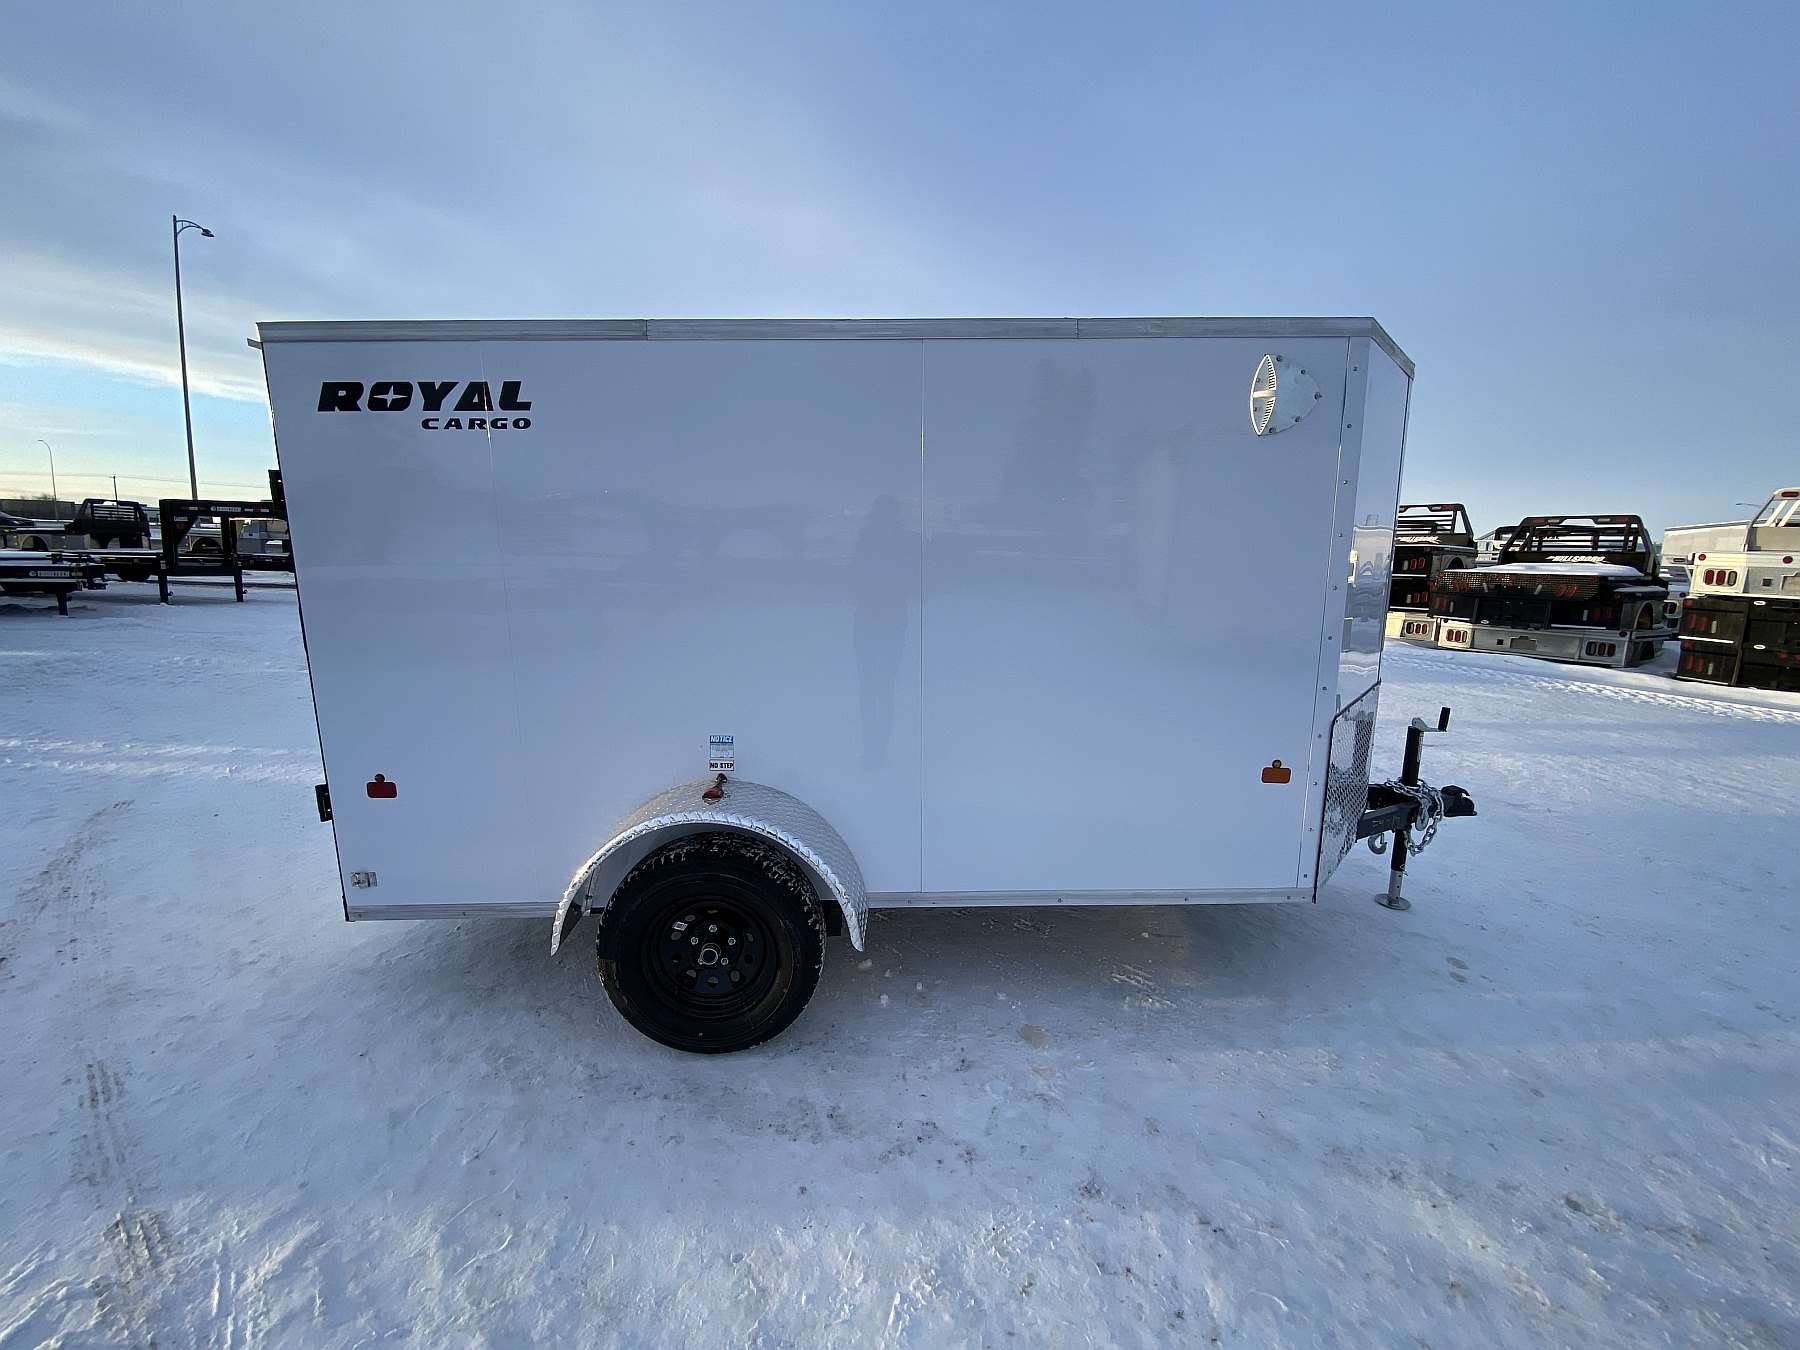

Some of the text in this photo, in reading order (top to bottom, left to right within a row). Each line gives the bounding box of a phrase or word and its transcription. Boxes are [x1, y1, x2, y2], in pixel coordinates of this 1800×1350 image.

[317, 380, 532, 412] ROYAL
[421, 417, 532, 430] CARGO
[710, 735, 733, 743] NOTICE
